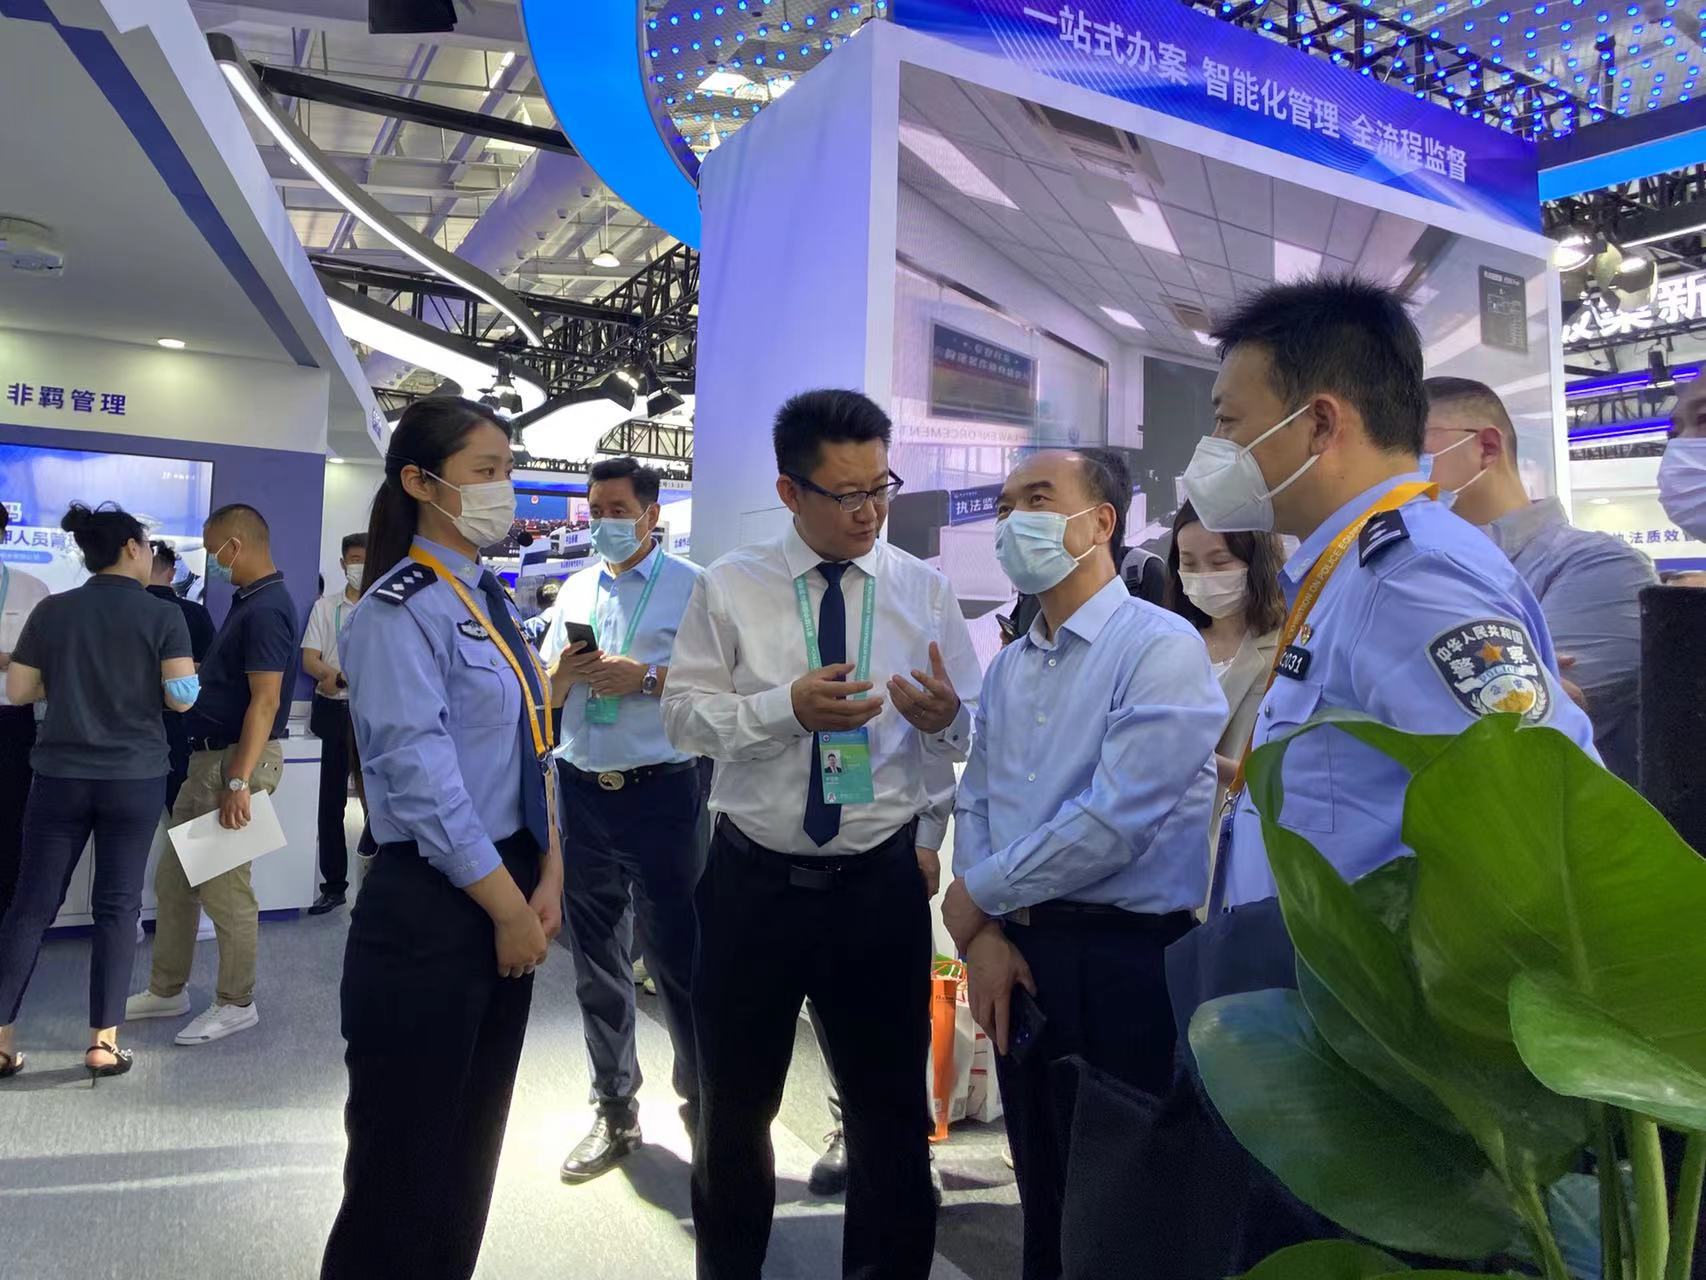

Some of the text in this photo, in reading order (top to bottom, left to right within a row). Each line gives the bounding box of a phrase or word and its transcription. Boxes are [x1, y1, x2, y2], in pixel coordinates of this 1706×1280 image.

[1023, 4, 1467, 183] 一站式办案 智能化管理 全流程监督
[7, 383, 126, 415] 非羁管理
[956, 497, 999, 515] 执法监
[1319, 550, 1341, 580] POLICE
[1436, 624, 1524, 662] 中华人民共和国
